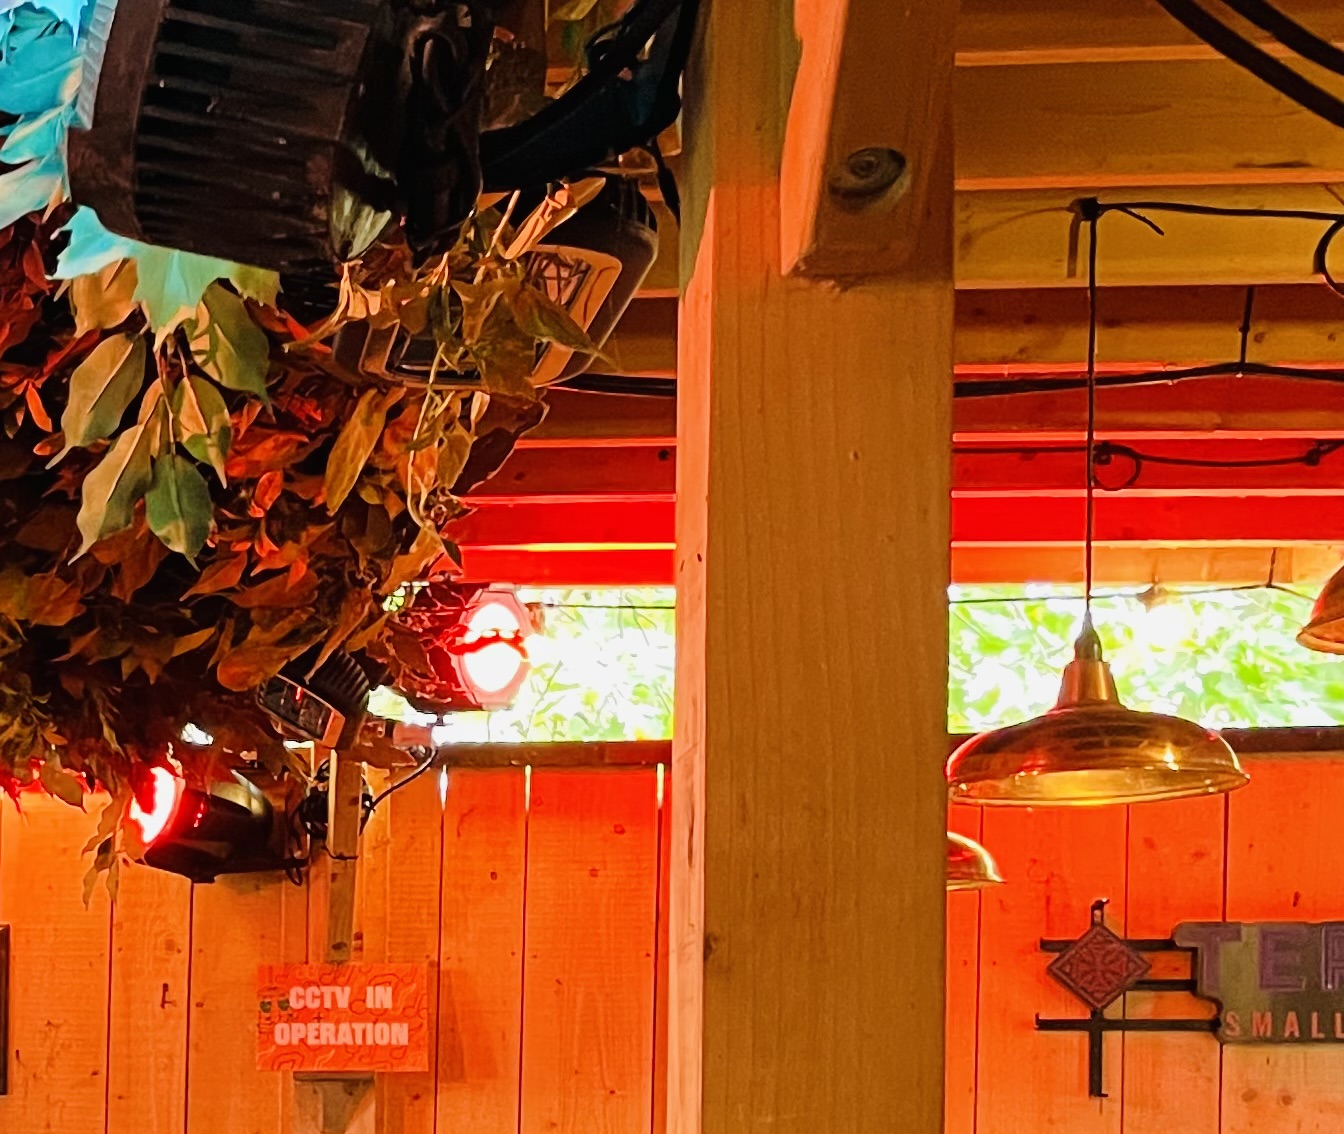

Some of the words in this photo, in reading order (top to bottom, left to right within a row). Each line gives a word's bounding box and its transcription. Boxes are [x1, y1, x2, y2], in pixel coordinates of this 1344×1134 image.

[289, 986, 351, 1010] CCTV
[366, 986, 393, 1009] IN
[274, 1022, 409, 1046] OPERATION
[1225, 1010, 1344, 1040] SMALL
